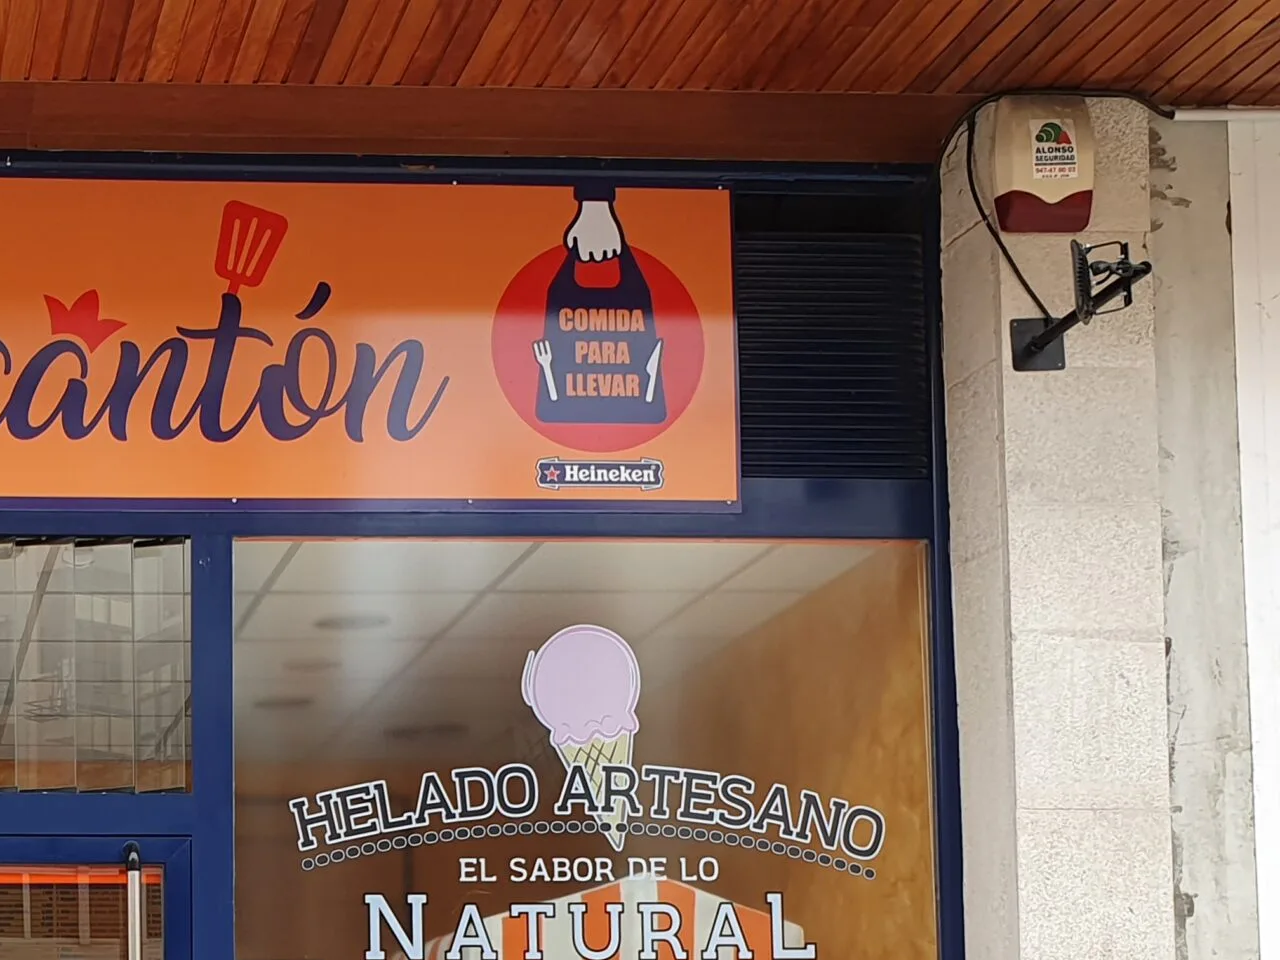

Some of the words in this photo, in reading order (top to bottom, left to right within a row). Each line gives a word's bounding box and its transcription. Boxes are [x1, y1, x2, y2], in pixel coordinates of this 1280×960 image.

[1036, 146, 1074, 154] ALONSO
[559, 307, 645, 332] COMIDA
[575, 341, 630, 364] PARA
[566, 373, 640, 397] LLEVAR
[564, 465, 656, 482] Heineken
[289, 763, 538, 851] HELADO
[554, 762, 885, 860] ARTESANO
[459, 858, 497, 882] EL
[509, 858, 615, 882] SABOR
[628, 857, 668, 881] DE
[680, 857, 719, 881] LO
